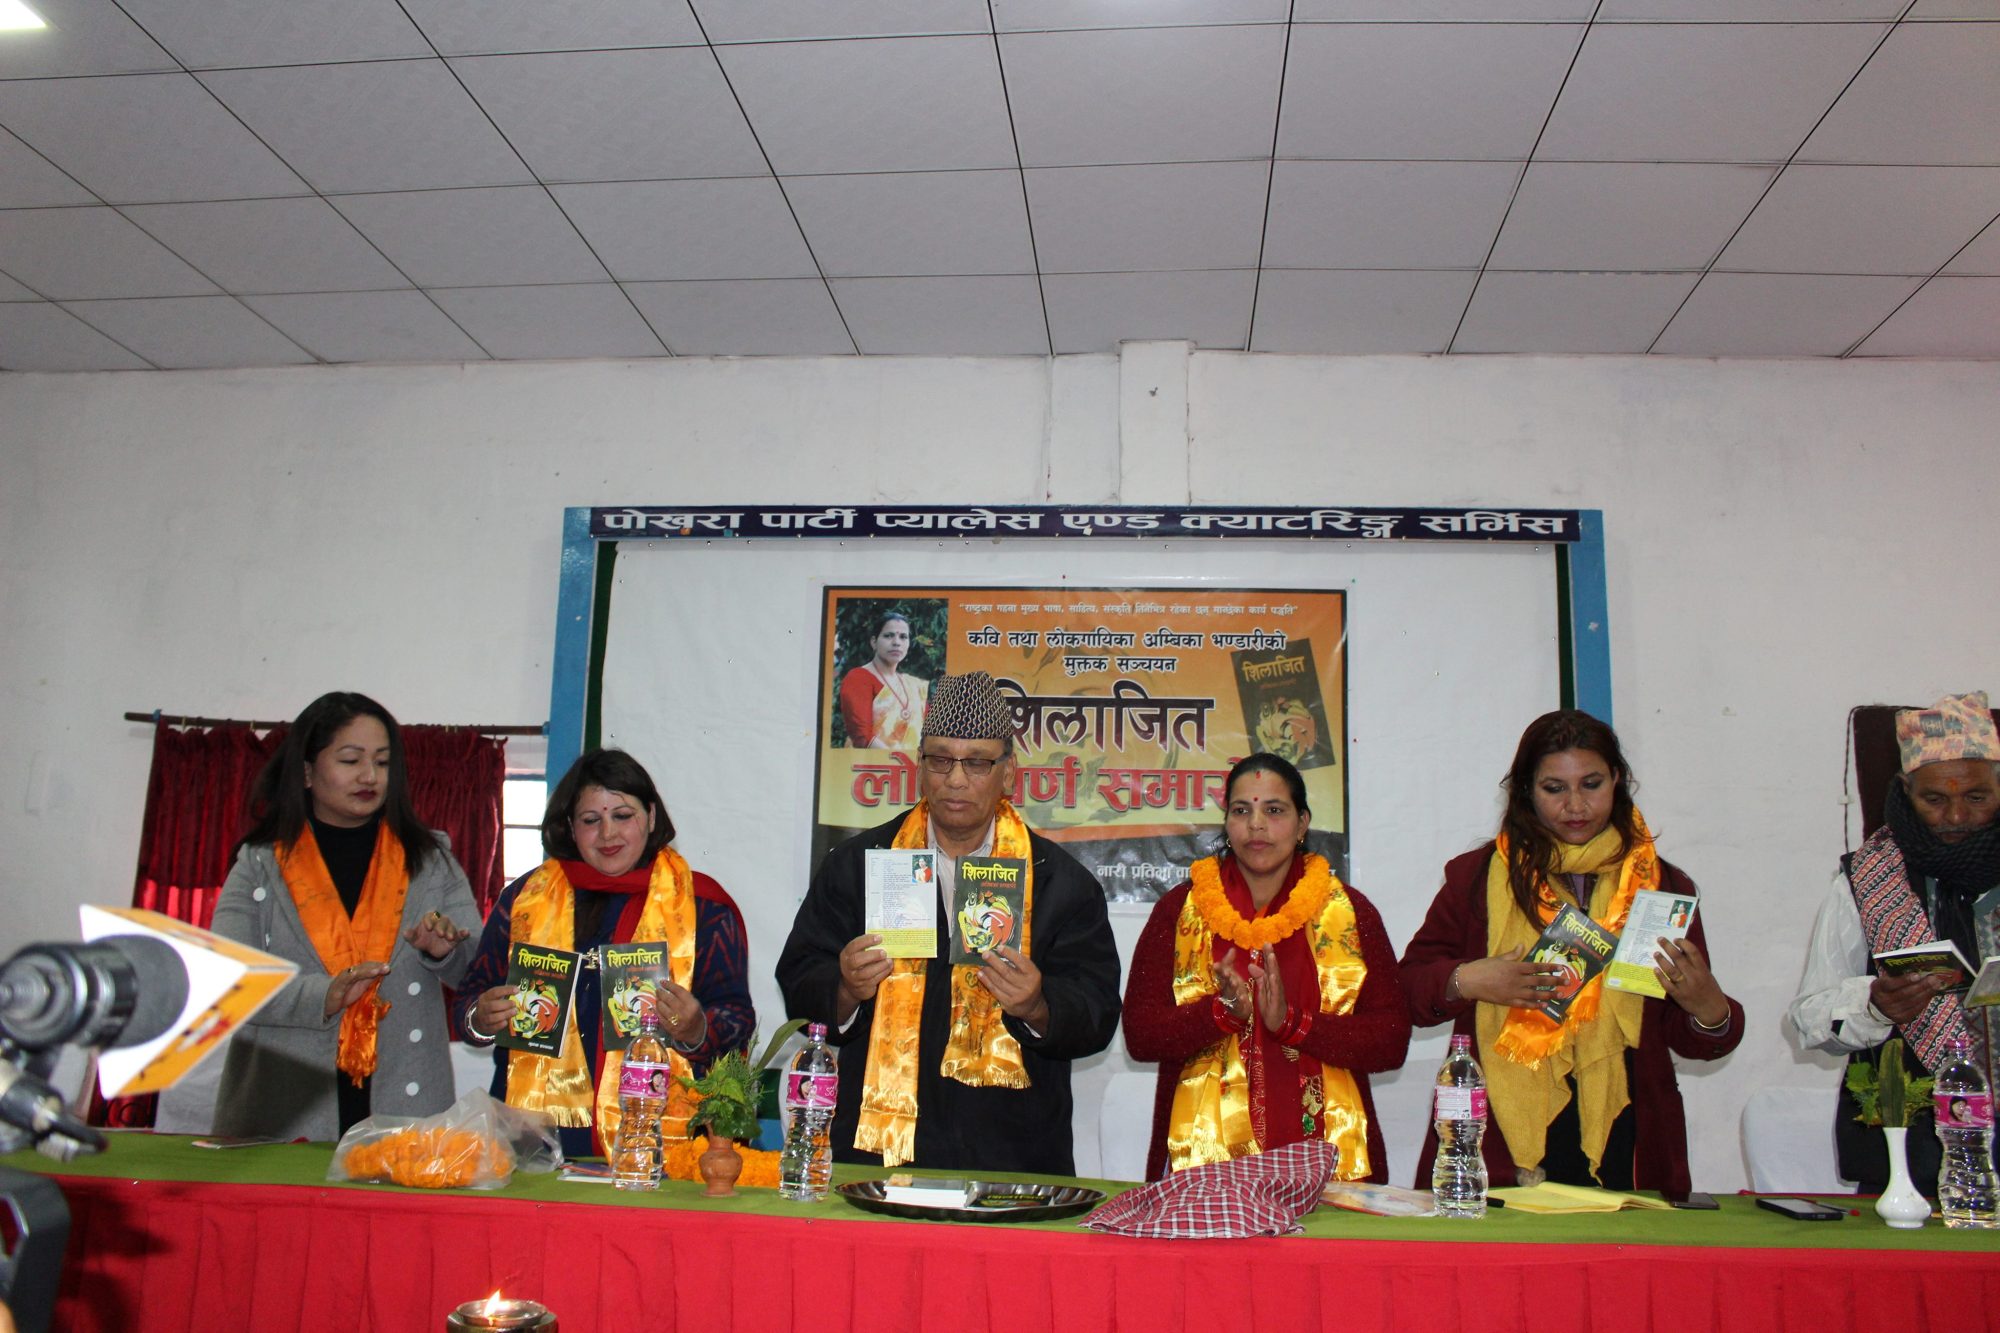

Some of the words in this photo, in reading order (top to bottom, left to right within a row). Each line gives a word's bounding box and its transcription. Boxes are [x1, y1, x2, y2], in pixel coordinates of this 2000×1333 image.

[602, 508, 745, 530] पोखरा
[759, 507, 859, 529] पार्टी
[873, 508, 1046, 530] प्यालेस
[1060, 513, 1165, 536] एण्ड
[1180, 509, 1404, 538] क्याटरिङ्ग
[1419, 511, 1568, 534] सर्भिस
[967, 625, 1001, 646] कवि
[1007, 631, 1039, 647] तथा
[1045, 626, 1135, 648] लोकगायिका
[1143, 626, 1204, 649] अम्बिका
[1211, 627, 1287, 651] भण्डारीको
[1063, 655, 1109, 677] मुक्तक
[1116, 656, 1178, 673] सञ्चयन
[1242, 655, 1305, 682] शिलाजित
[994, 677, 1216, 757] शिलाजित
[962, 862, 1019, 882] शिलाजित
[1096, 862, 1127, 879] नारी
[1560, 911, 1613, 957] शिलाजित
[518, 948, 571, 974] शिलाजित
[607, 948, 662, 968] शिलाजित
